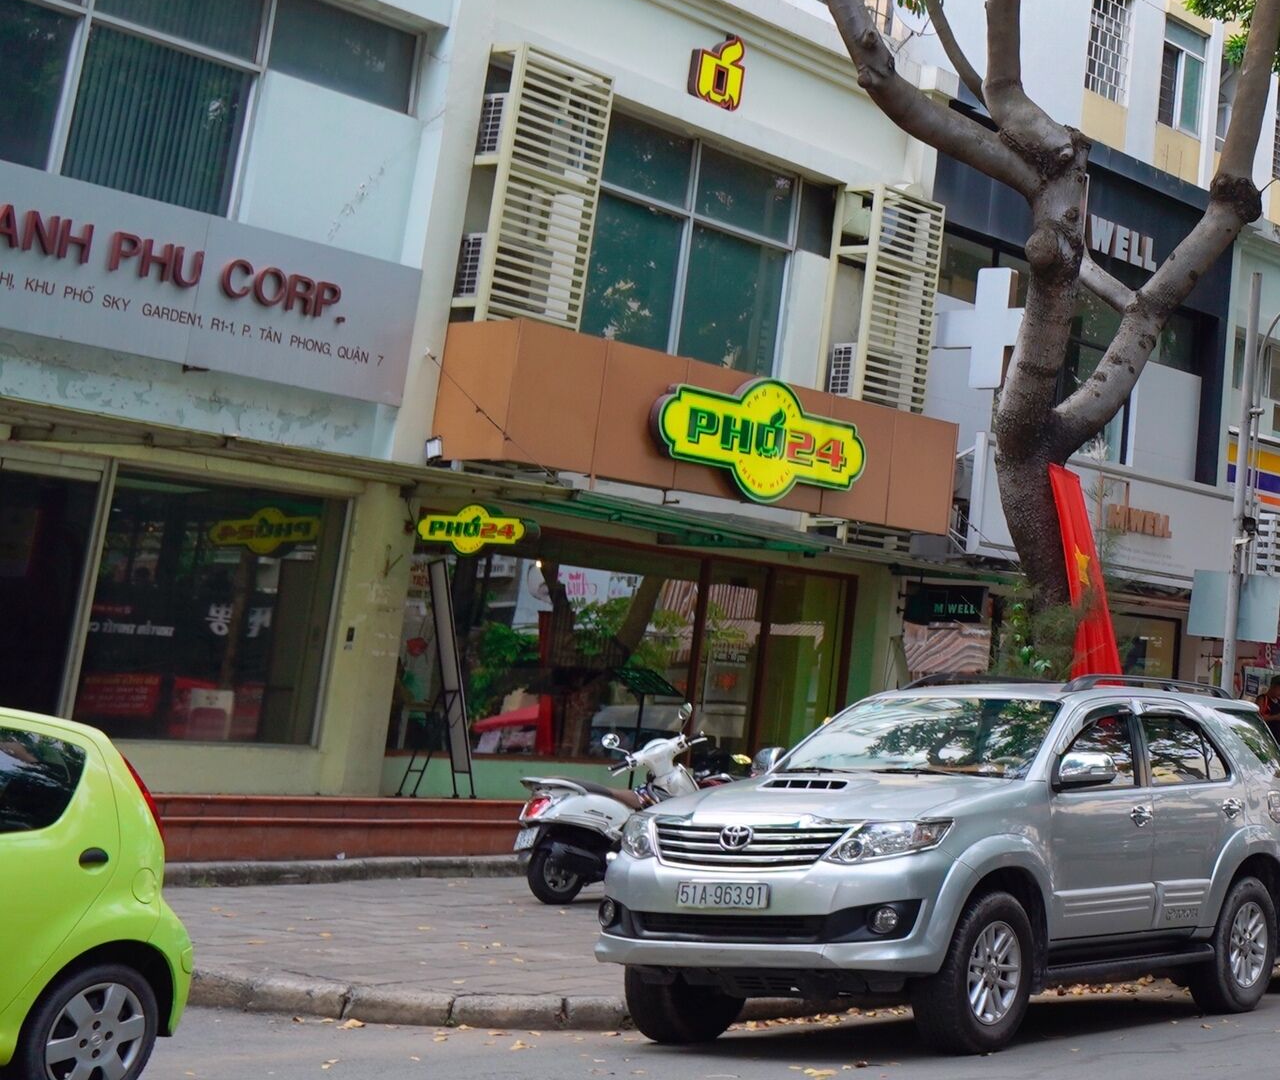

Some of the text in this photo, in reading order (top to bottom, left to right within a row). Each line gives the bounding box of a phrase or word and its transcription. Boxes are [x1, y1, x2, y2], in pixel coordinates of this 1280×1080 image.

[108, 231, 205, 289] PHU
[220, 259, 346, 325] CORP.
[1085, 213, 1157, 273] WELL
[24, 277, 56, 296] KHU
[63, 284, 94, 304] PHỐ
[102, 294, 131, 313] SKY
[142, 302, 203, 329] GARDEN1,
[242, 324, 252, 338] P.
[259, 325, 282, 345] TÂN
[290, 335, 333, 358] PHONG,
[337, 343, 369, 365] QUẬN
[377, 355, 384, 367] 7
[680, 883, 764, 906] 51A-963.91
